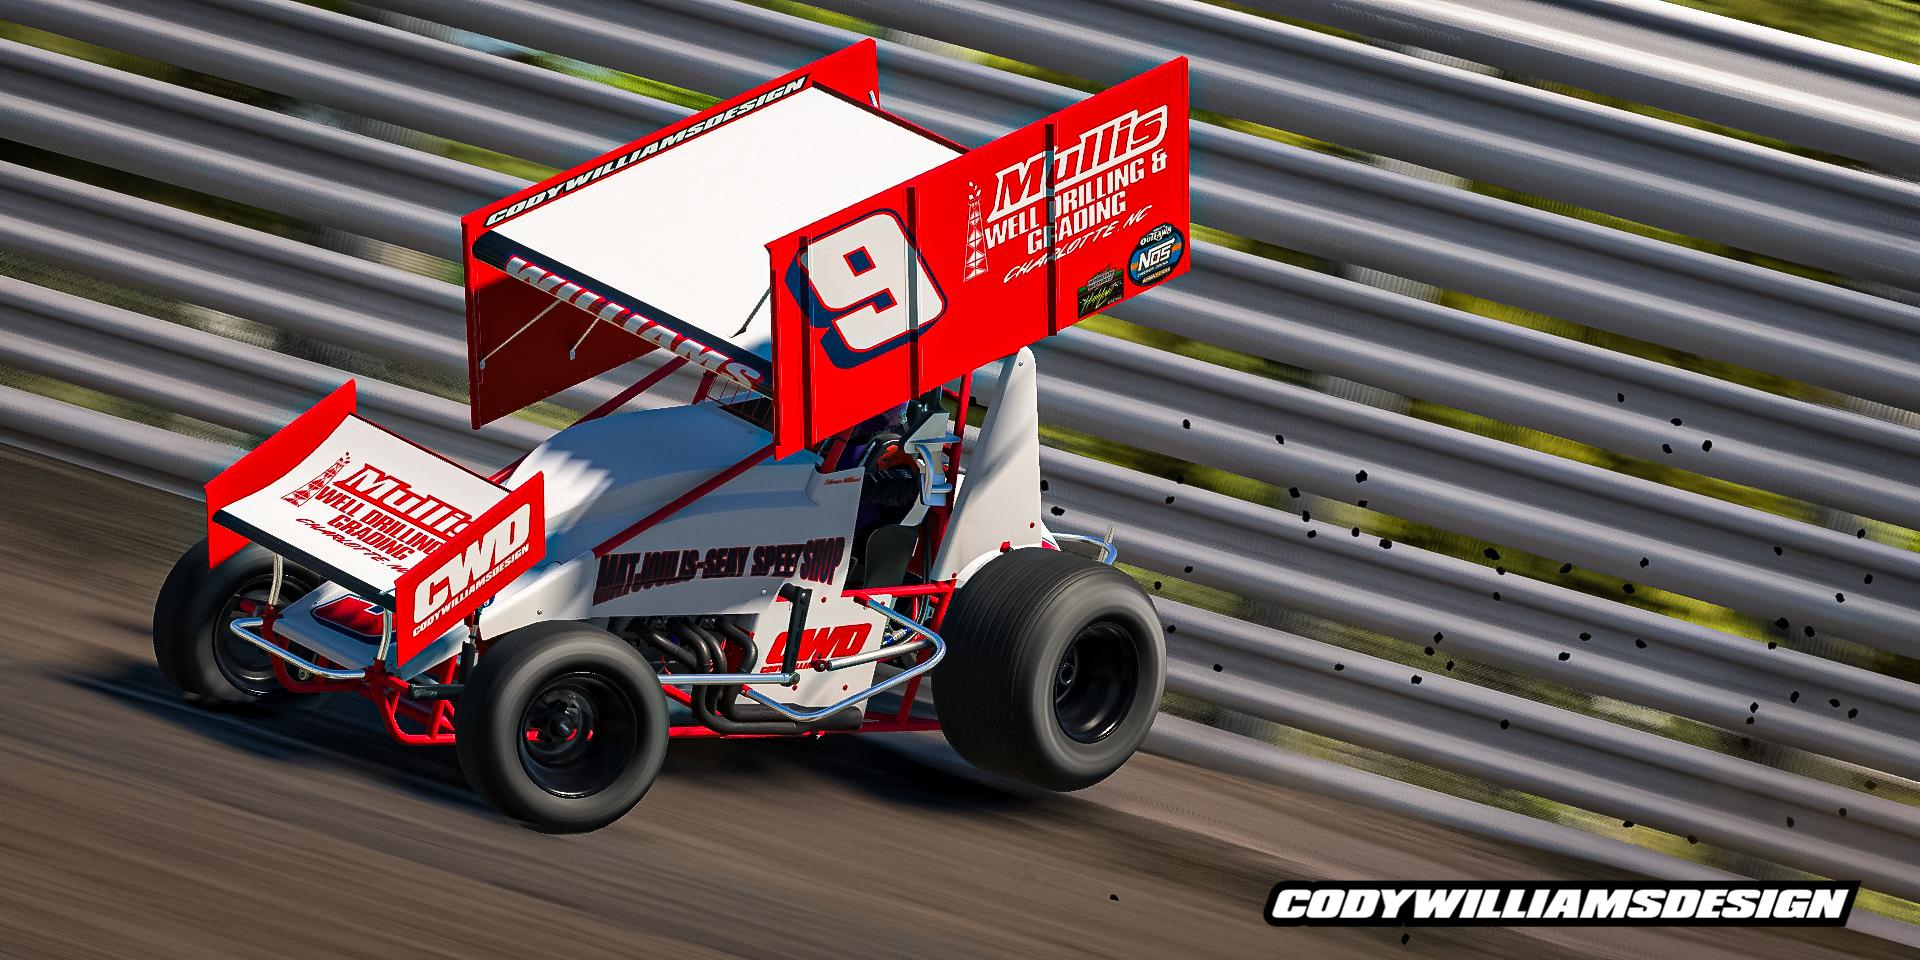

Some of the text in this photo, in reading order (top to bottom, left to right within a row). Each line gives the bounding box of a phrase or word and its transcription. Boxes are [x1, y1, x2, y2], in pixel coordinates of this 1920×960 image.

[485, 76, 808, 227] CODYWILLIAMSDESIGN
[984, 148, 1168, 249] WELL DRILLING &
[987, 105, 1168, 222] Mullis
[1027, 191, 1126, 255] GRADING
[1122, 205, 1153, 229] NC
[1138, 237, 1176, 272] NOS
[504, 254, 764, 389] WILLIAMS
[792, 208, 948, 355] 9
[315, 485, 365, 518] WELL
[327, 514, 415, 560] GRADING
[412, 543, 530, 637] CODYWILLIAMSDESIGN
[413, 503, 531, 625] CWD
